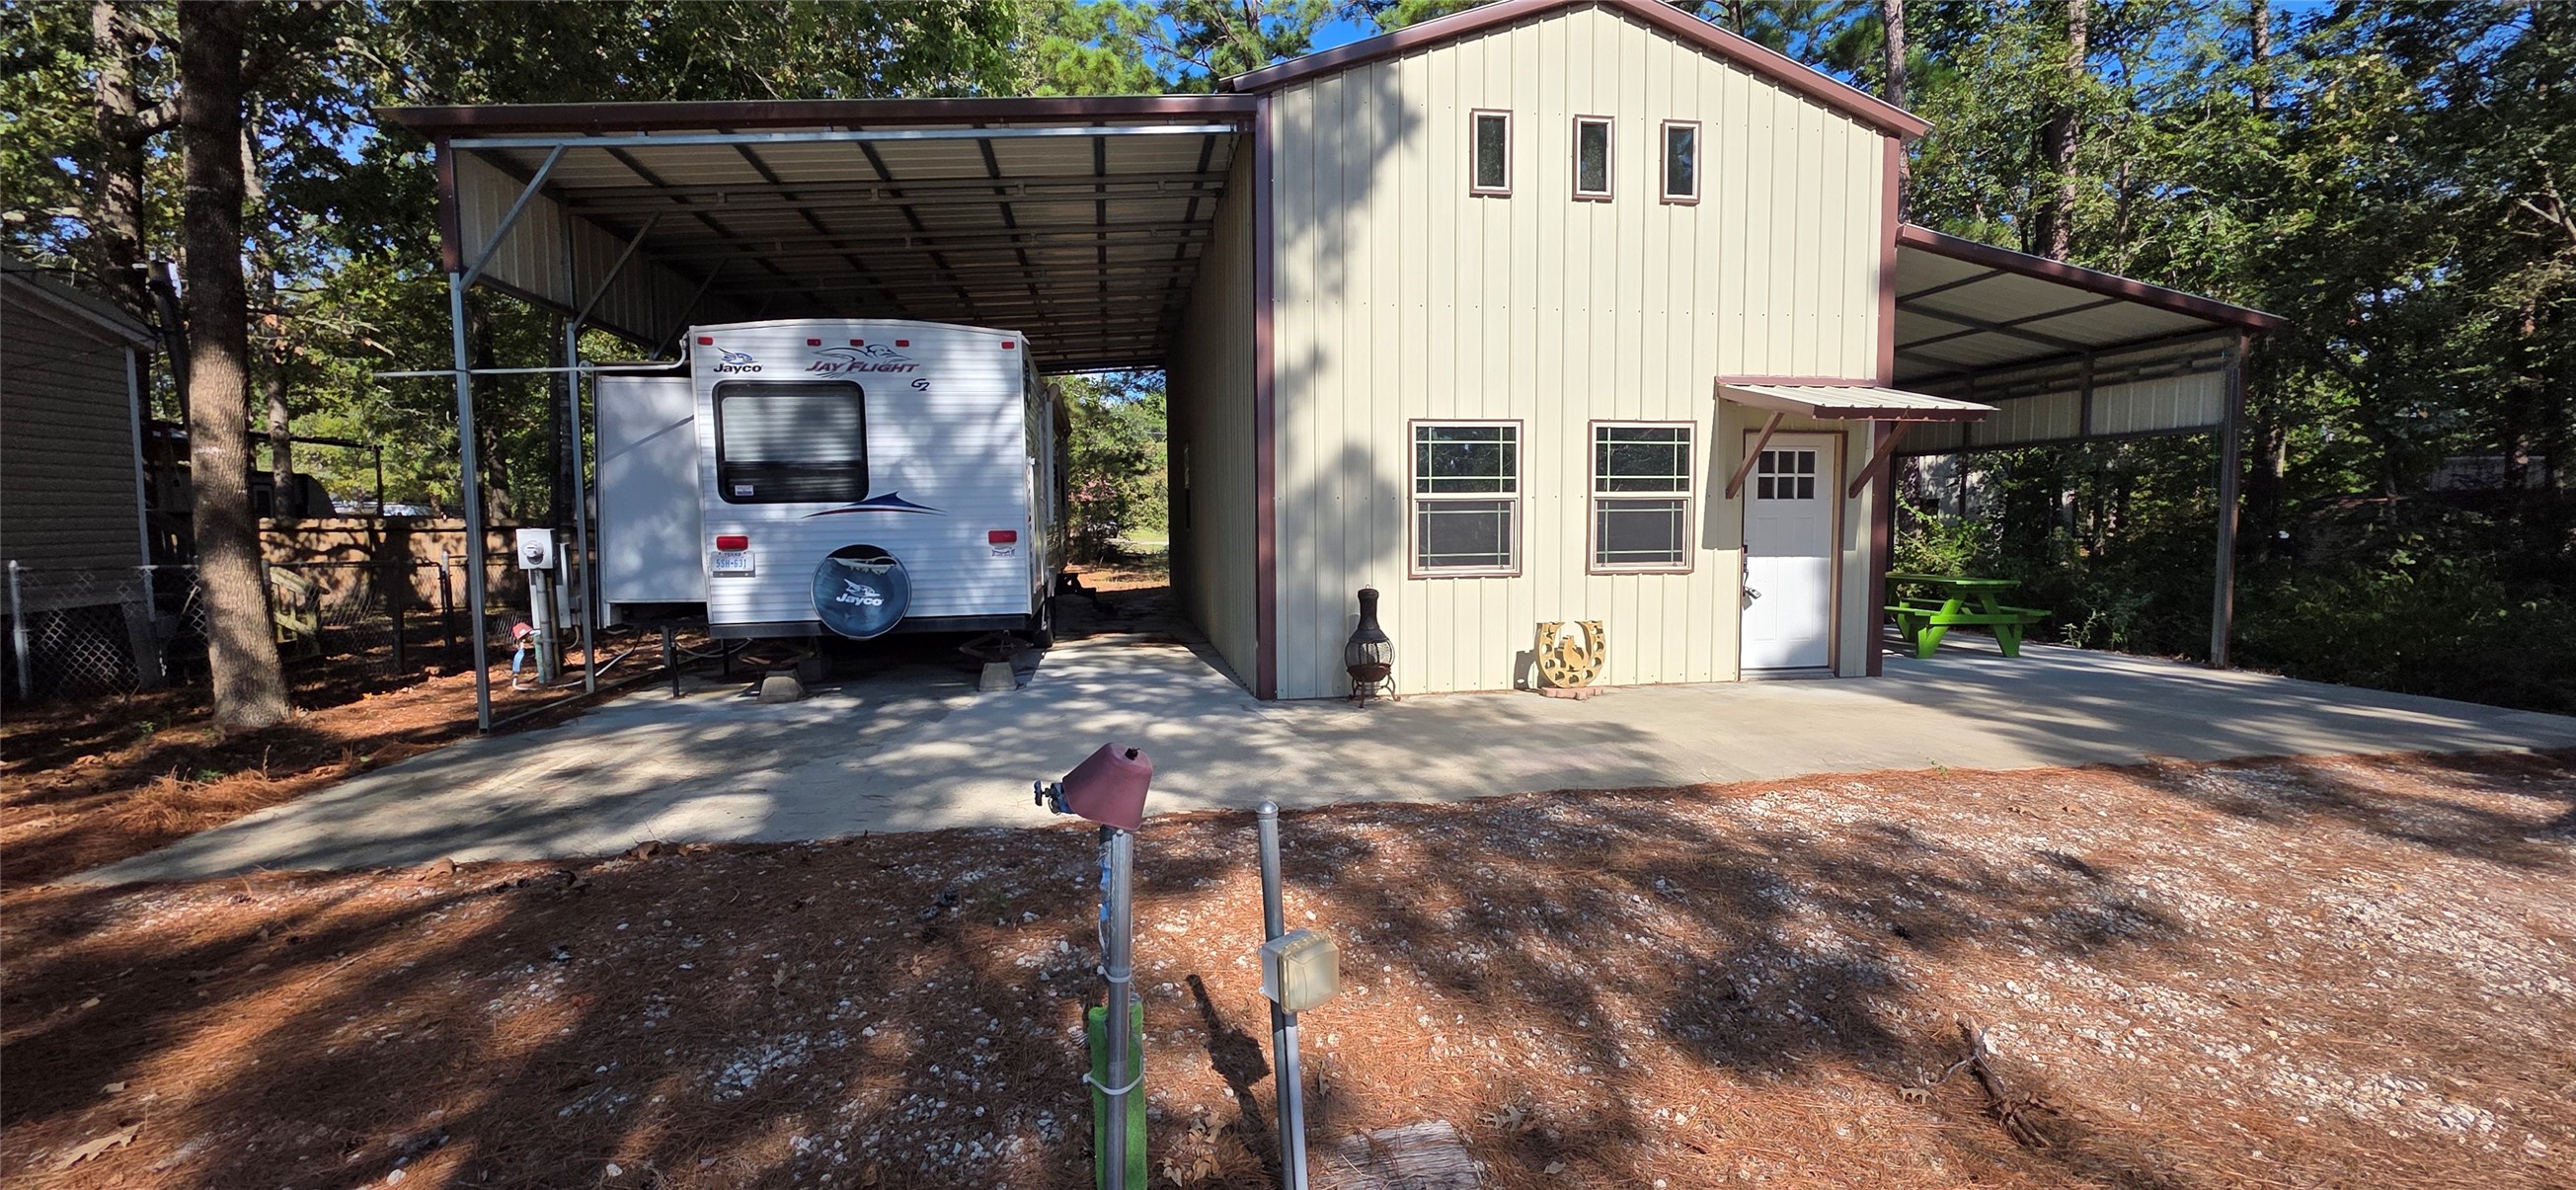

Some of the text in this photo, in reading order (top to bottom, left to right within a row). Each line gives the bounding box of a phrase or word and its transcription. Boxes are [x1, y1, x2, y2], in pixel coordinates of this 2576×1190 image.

[713, 362, 762, 374] Jayco
[805, 360, 920, 373] JAY FLIGHT
[910, 378, 930, 392] G2
[835, 593, 883, 605] Jayco
